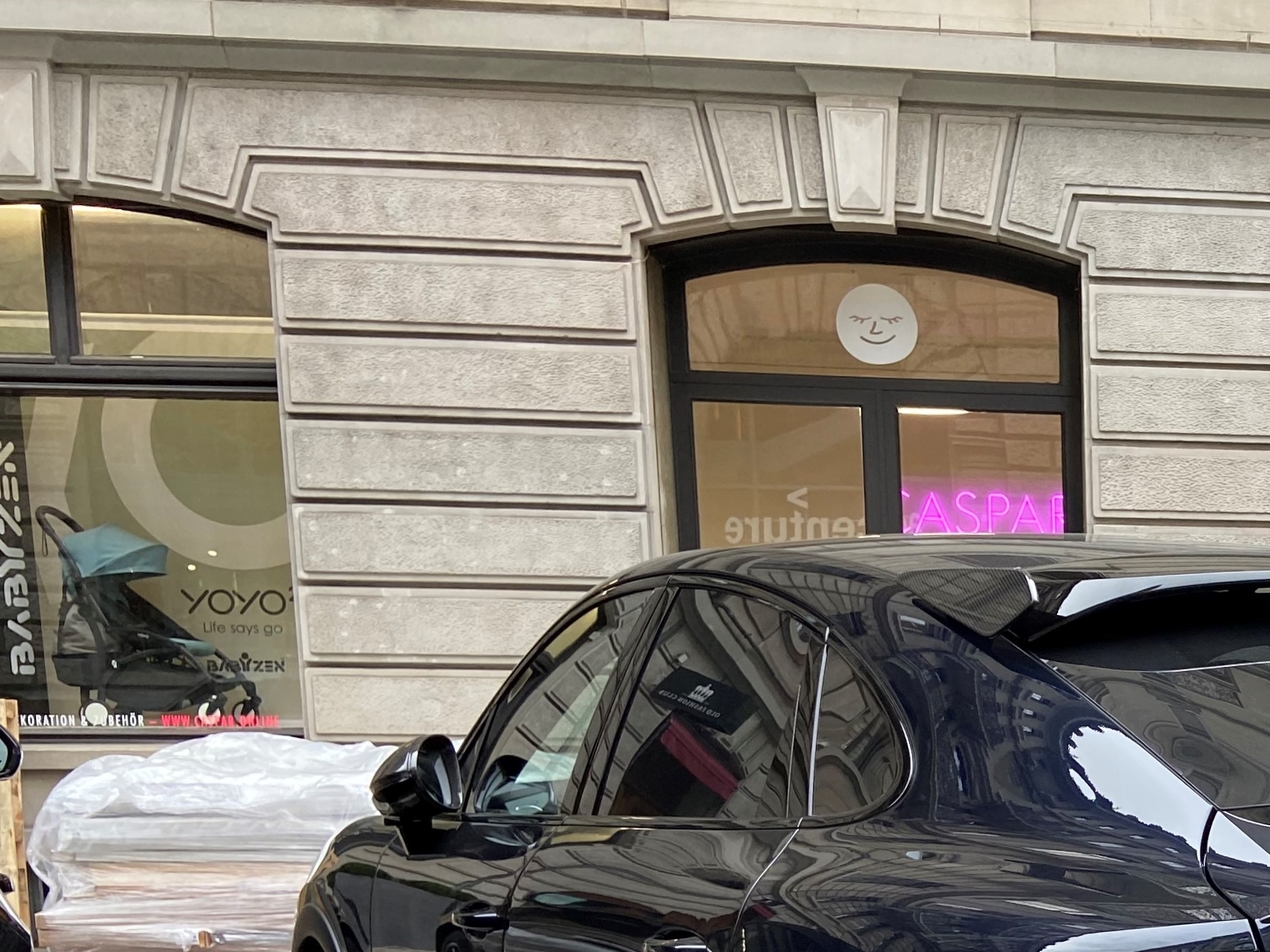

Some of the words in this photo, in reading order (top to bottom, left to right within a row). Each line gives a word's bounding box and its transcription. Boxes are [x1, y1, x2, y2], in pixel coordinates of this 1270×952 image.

[203, 621, 226, 634] Life
[231, 625, 259, 636] says
[263, 625, 283, 637] go
[18, 714, 75, 727] KORATION
